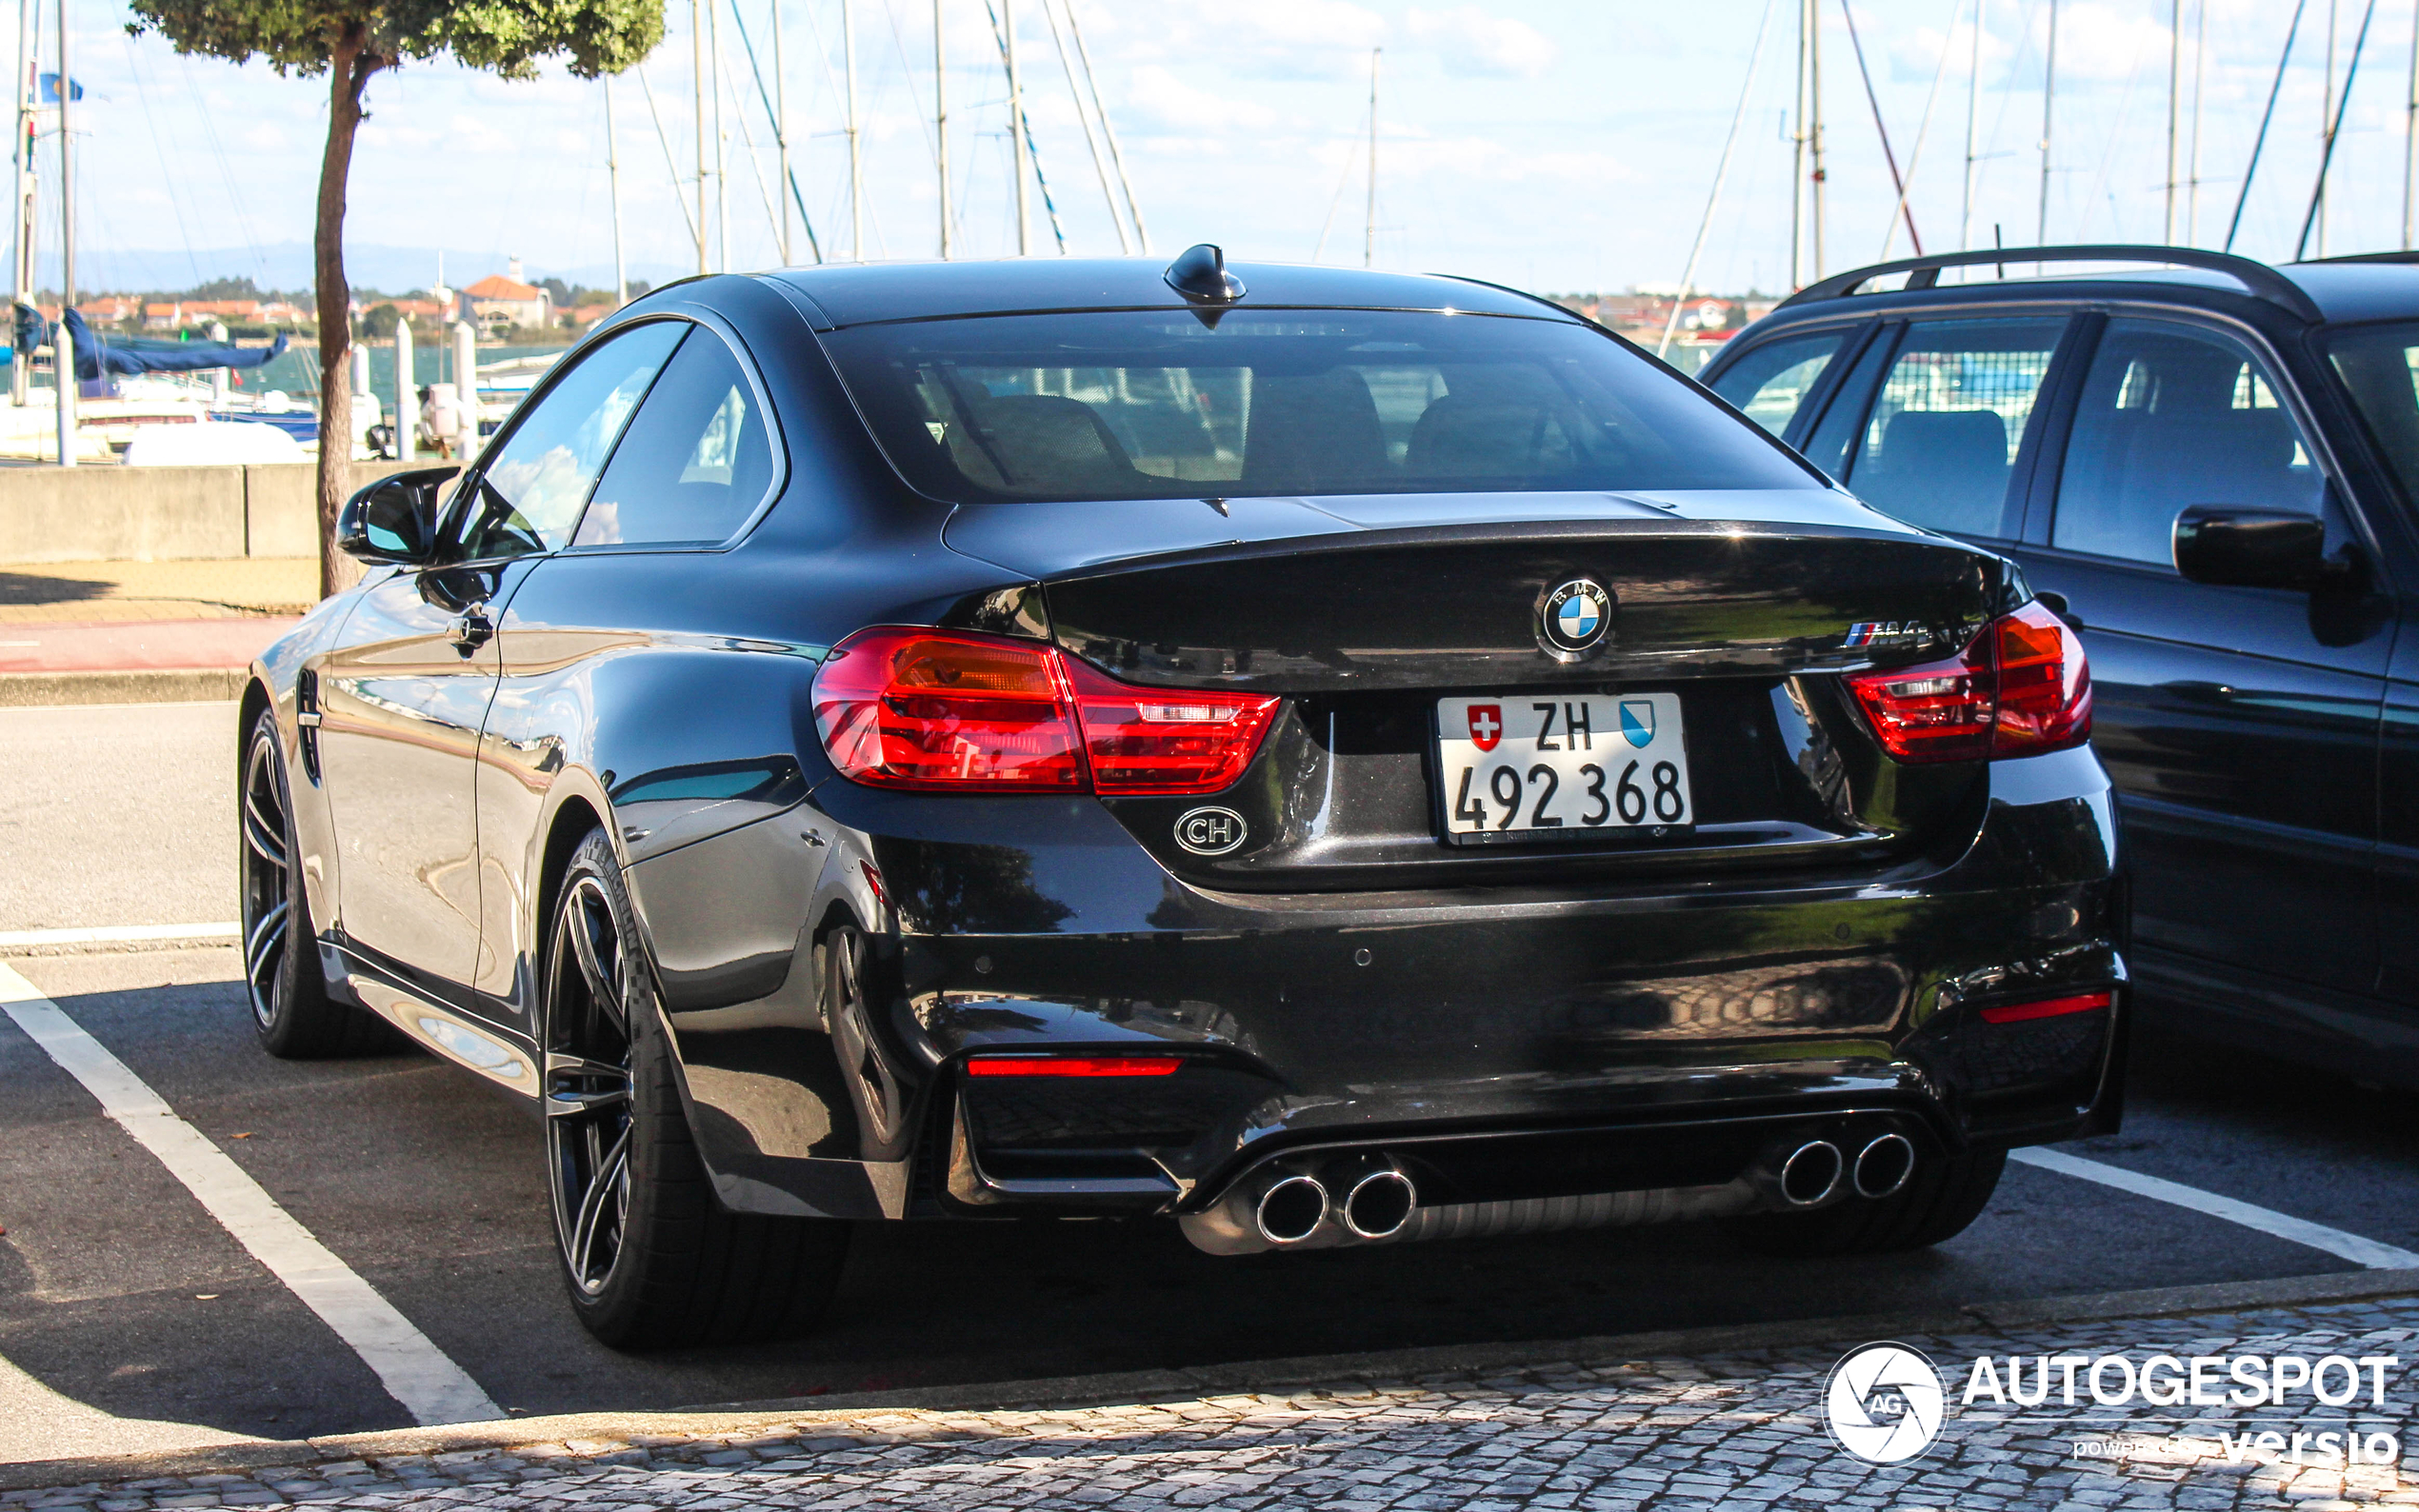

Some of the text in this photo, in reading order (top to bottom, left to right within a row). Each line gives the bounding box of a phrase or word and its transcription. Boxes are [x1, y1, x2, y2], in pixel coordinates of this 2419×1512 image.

[1553, 582, 1607, 605] BMW
[1532, 702, 1592, 750] ZH
[1455, 760, 1684, 829] 492 368
[1187, 819, 1231, 844] CH
[604, 856, 639, 950] MICHELIN
